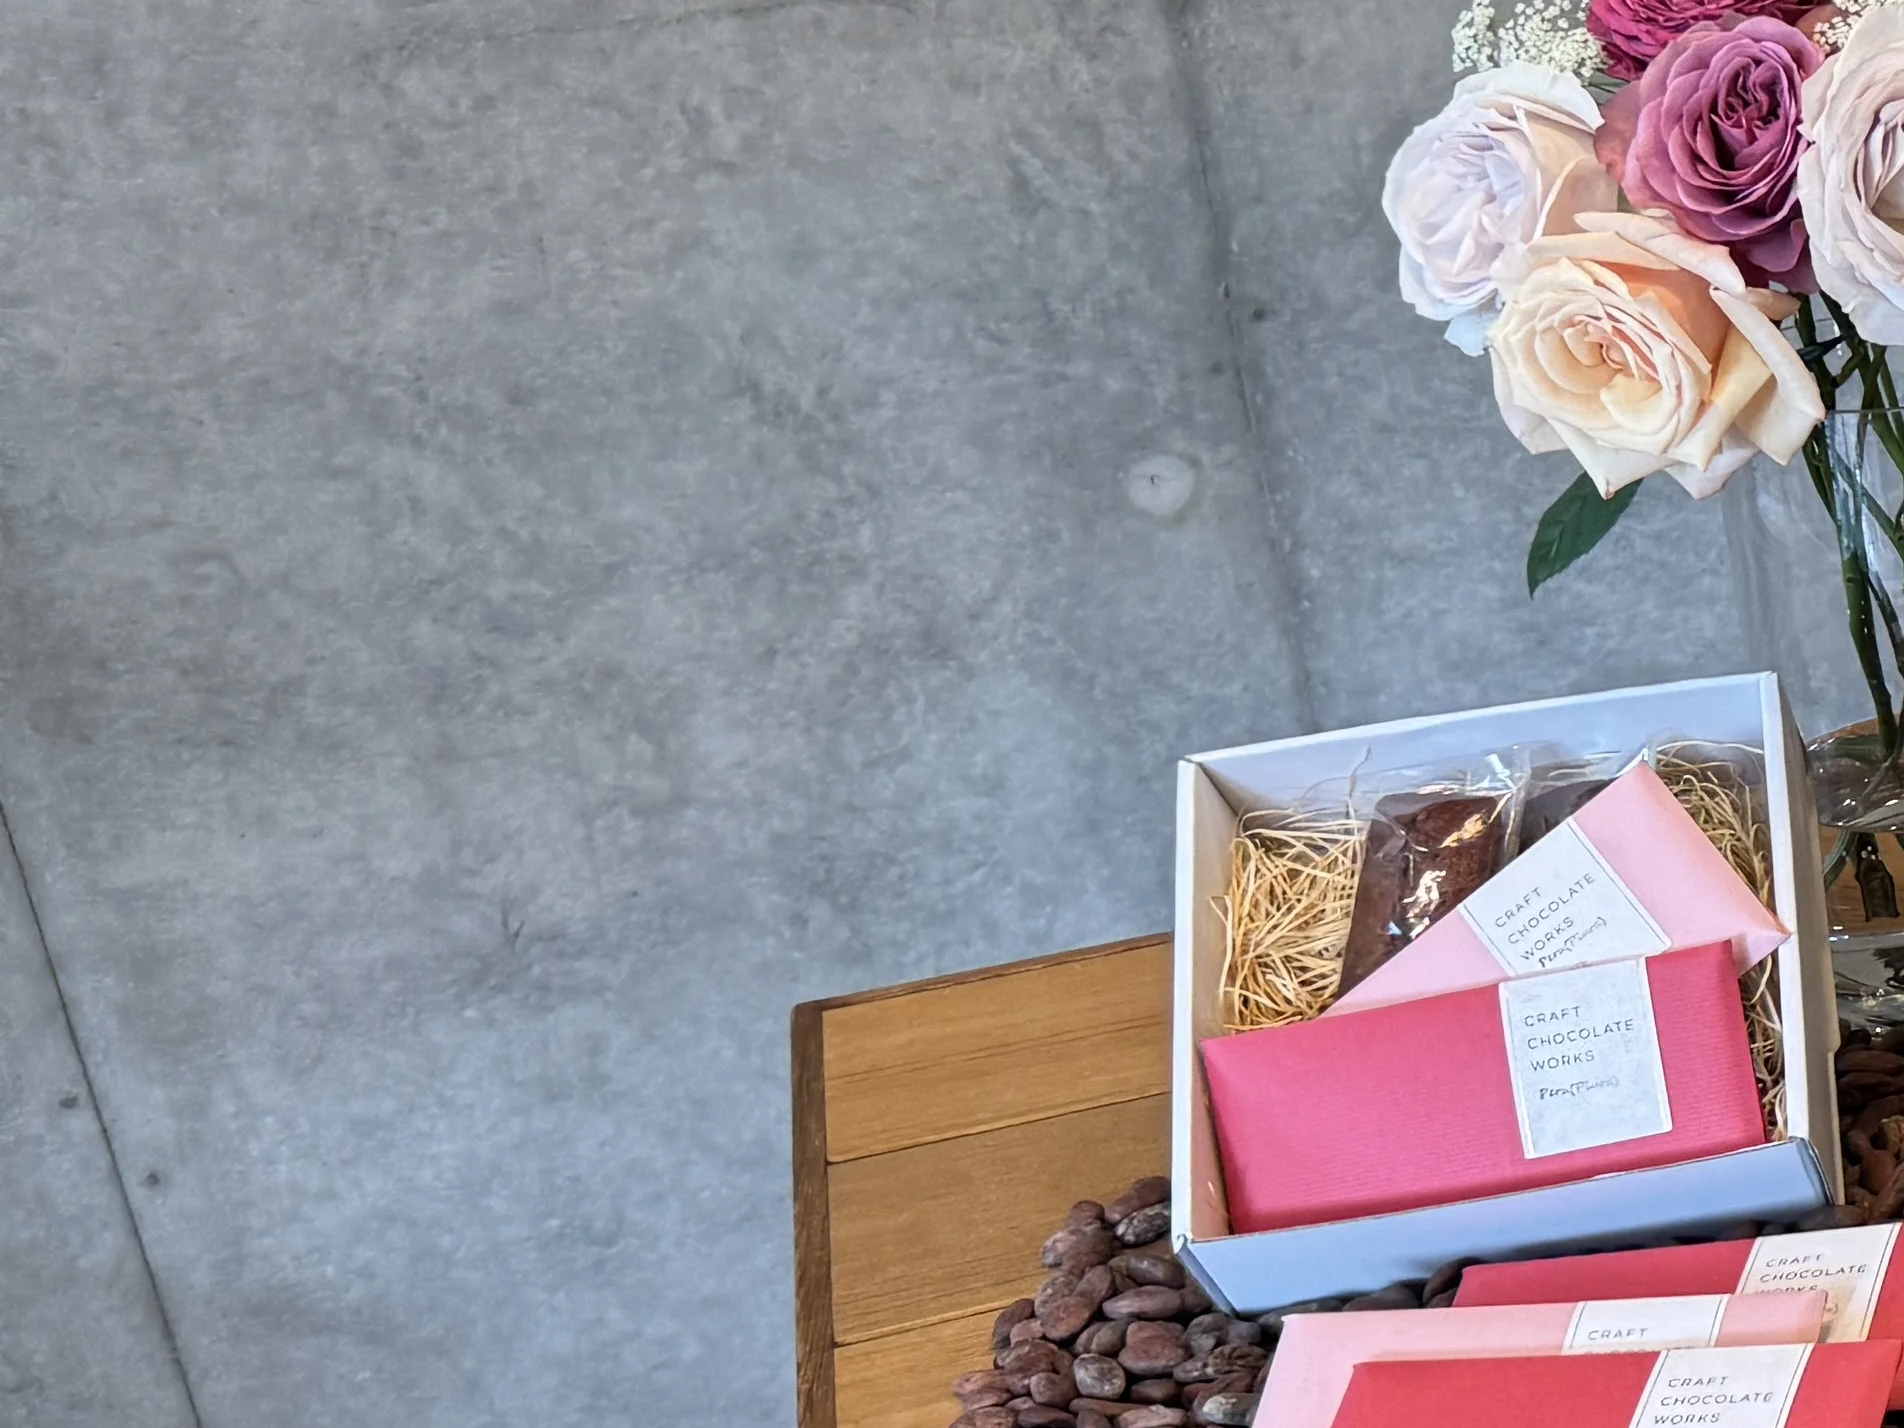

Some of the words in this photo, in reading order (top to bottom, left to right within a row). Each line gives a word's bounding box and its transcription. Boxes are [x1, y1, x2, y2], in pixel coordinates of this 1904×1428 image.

[1494, 887, 1541, 928] CRAFT
[1508, 873, 1596, 944] CHOCOLATE
[1520, 917, 1574, 960] WORKS
[1524, 1006, 1580, 1027] CRAFT
[1527, 1019, 1634, 1050] CHOCOLATE
[1530, 1050, 1595, 1072] WORKS
[1765, 1254, 1824, 1268] CRAFT
[1760, 1264, 1867, 1283] CHOCOLATE
[1587, 1327, 1649, 1341] CRAFT
[1668, 1376, 1729, 1388] CRAFT
[1660, 1392, 1774, 1406] CHOCOLATE
[1653, 1413, 1720, 1425] WORKS
